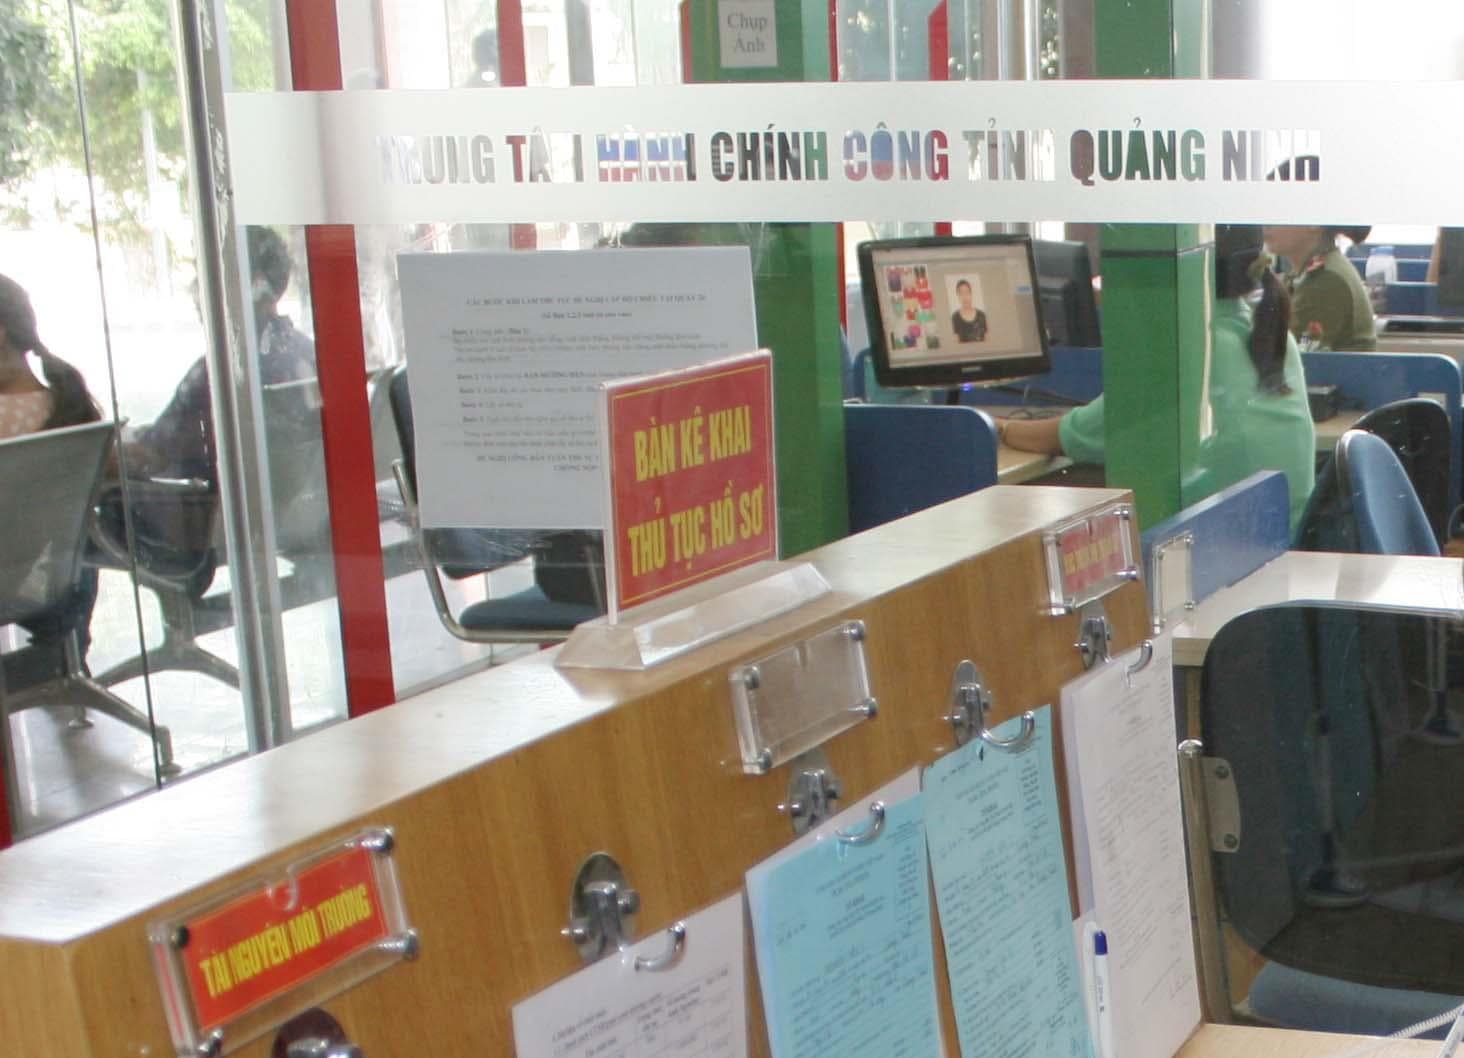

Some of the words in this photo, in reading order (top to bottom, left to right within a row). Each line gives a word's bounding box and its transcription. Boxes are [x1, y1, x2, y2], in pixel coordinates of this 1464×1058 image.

[595, 124, 697, 183] HÀNH
[710, 123, 829, 183] CHÍNH
[843, 121, 950, 182] CÔNG
[962, 117, 1057, 181] TỈNH
[1070, 117, 1206, 187] QUẢNG
[1222, 129, 1320, 182] NINH
[680, 405, 705, 470] KÊ
[709, 404, 752, 462] KHAI
[627, 496, 667, 577] THỦ
[670, 505, 706, 571] TỤC
[710, 479, 735, 550] HỒ
[739, 482, 765, 540] SƠ
